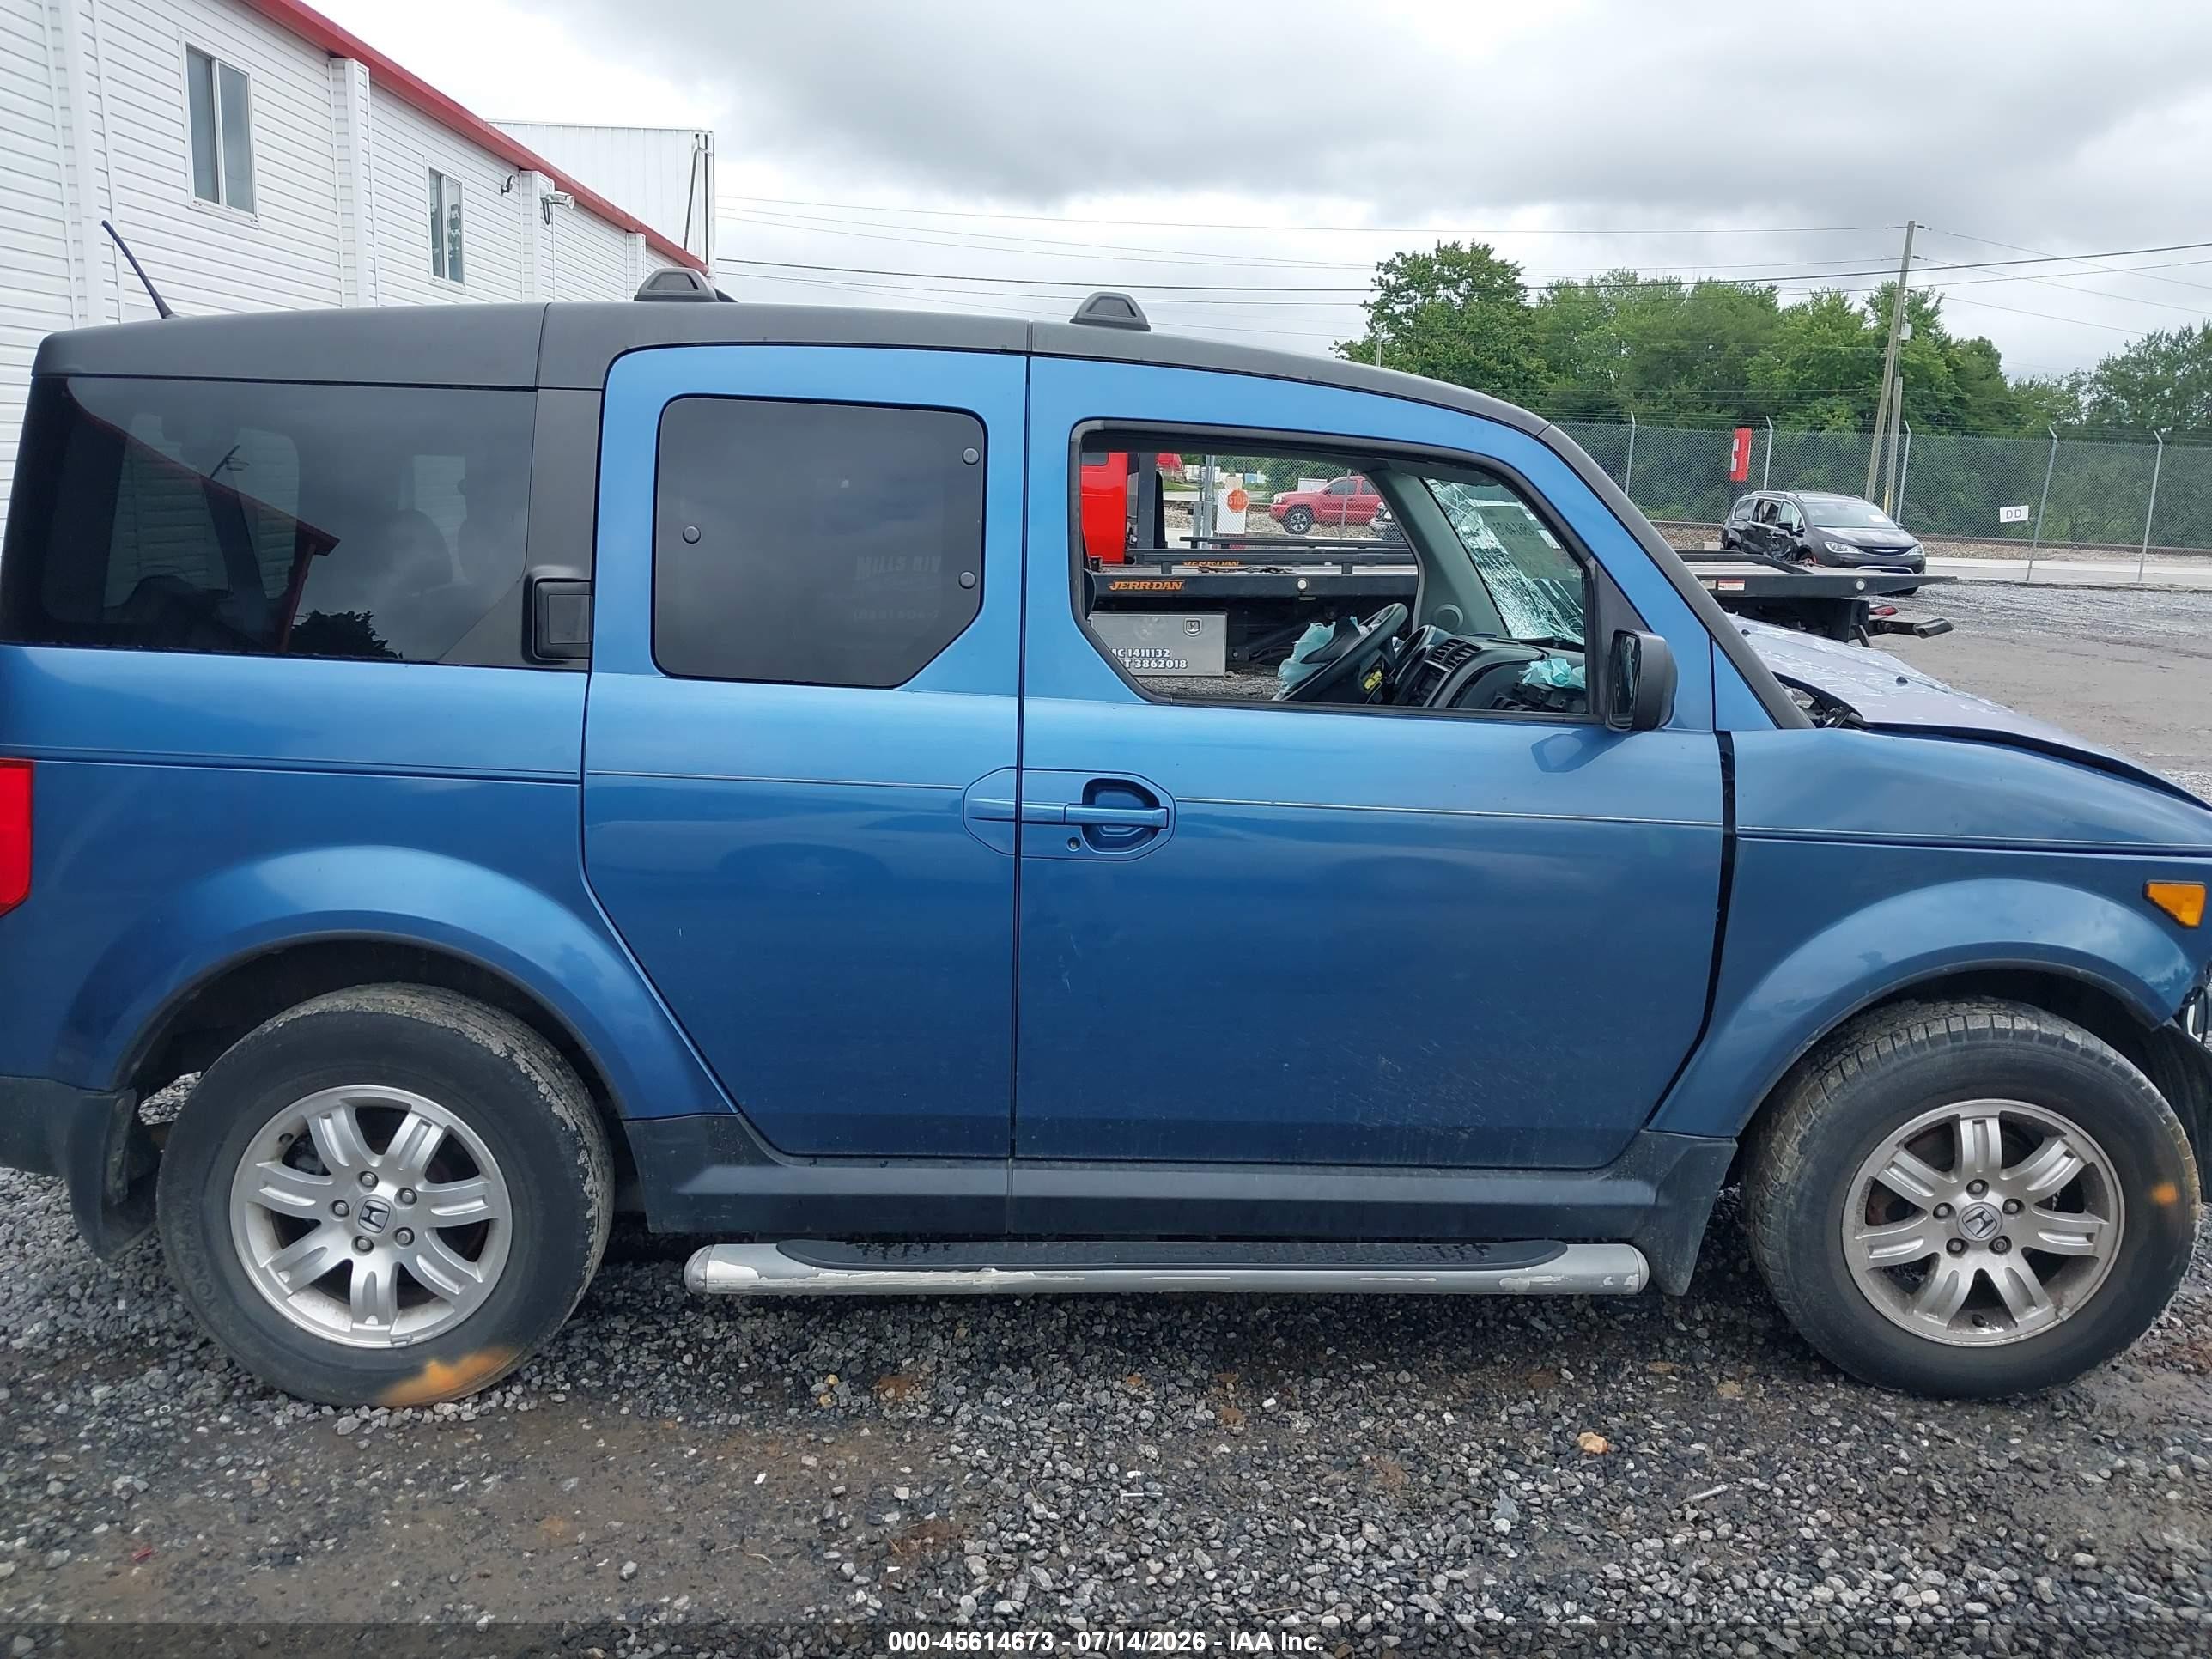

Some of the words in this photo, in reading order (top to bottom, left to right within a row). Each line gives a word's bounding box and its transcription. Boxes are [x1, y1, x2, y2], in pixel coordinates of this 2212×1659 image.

[1229, 495, 1248, 506] STOP
[1127, 648, 1171, 659] 1411132
[1133, 659, 1188, 669] 3862018
